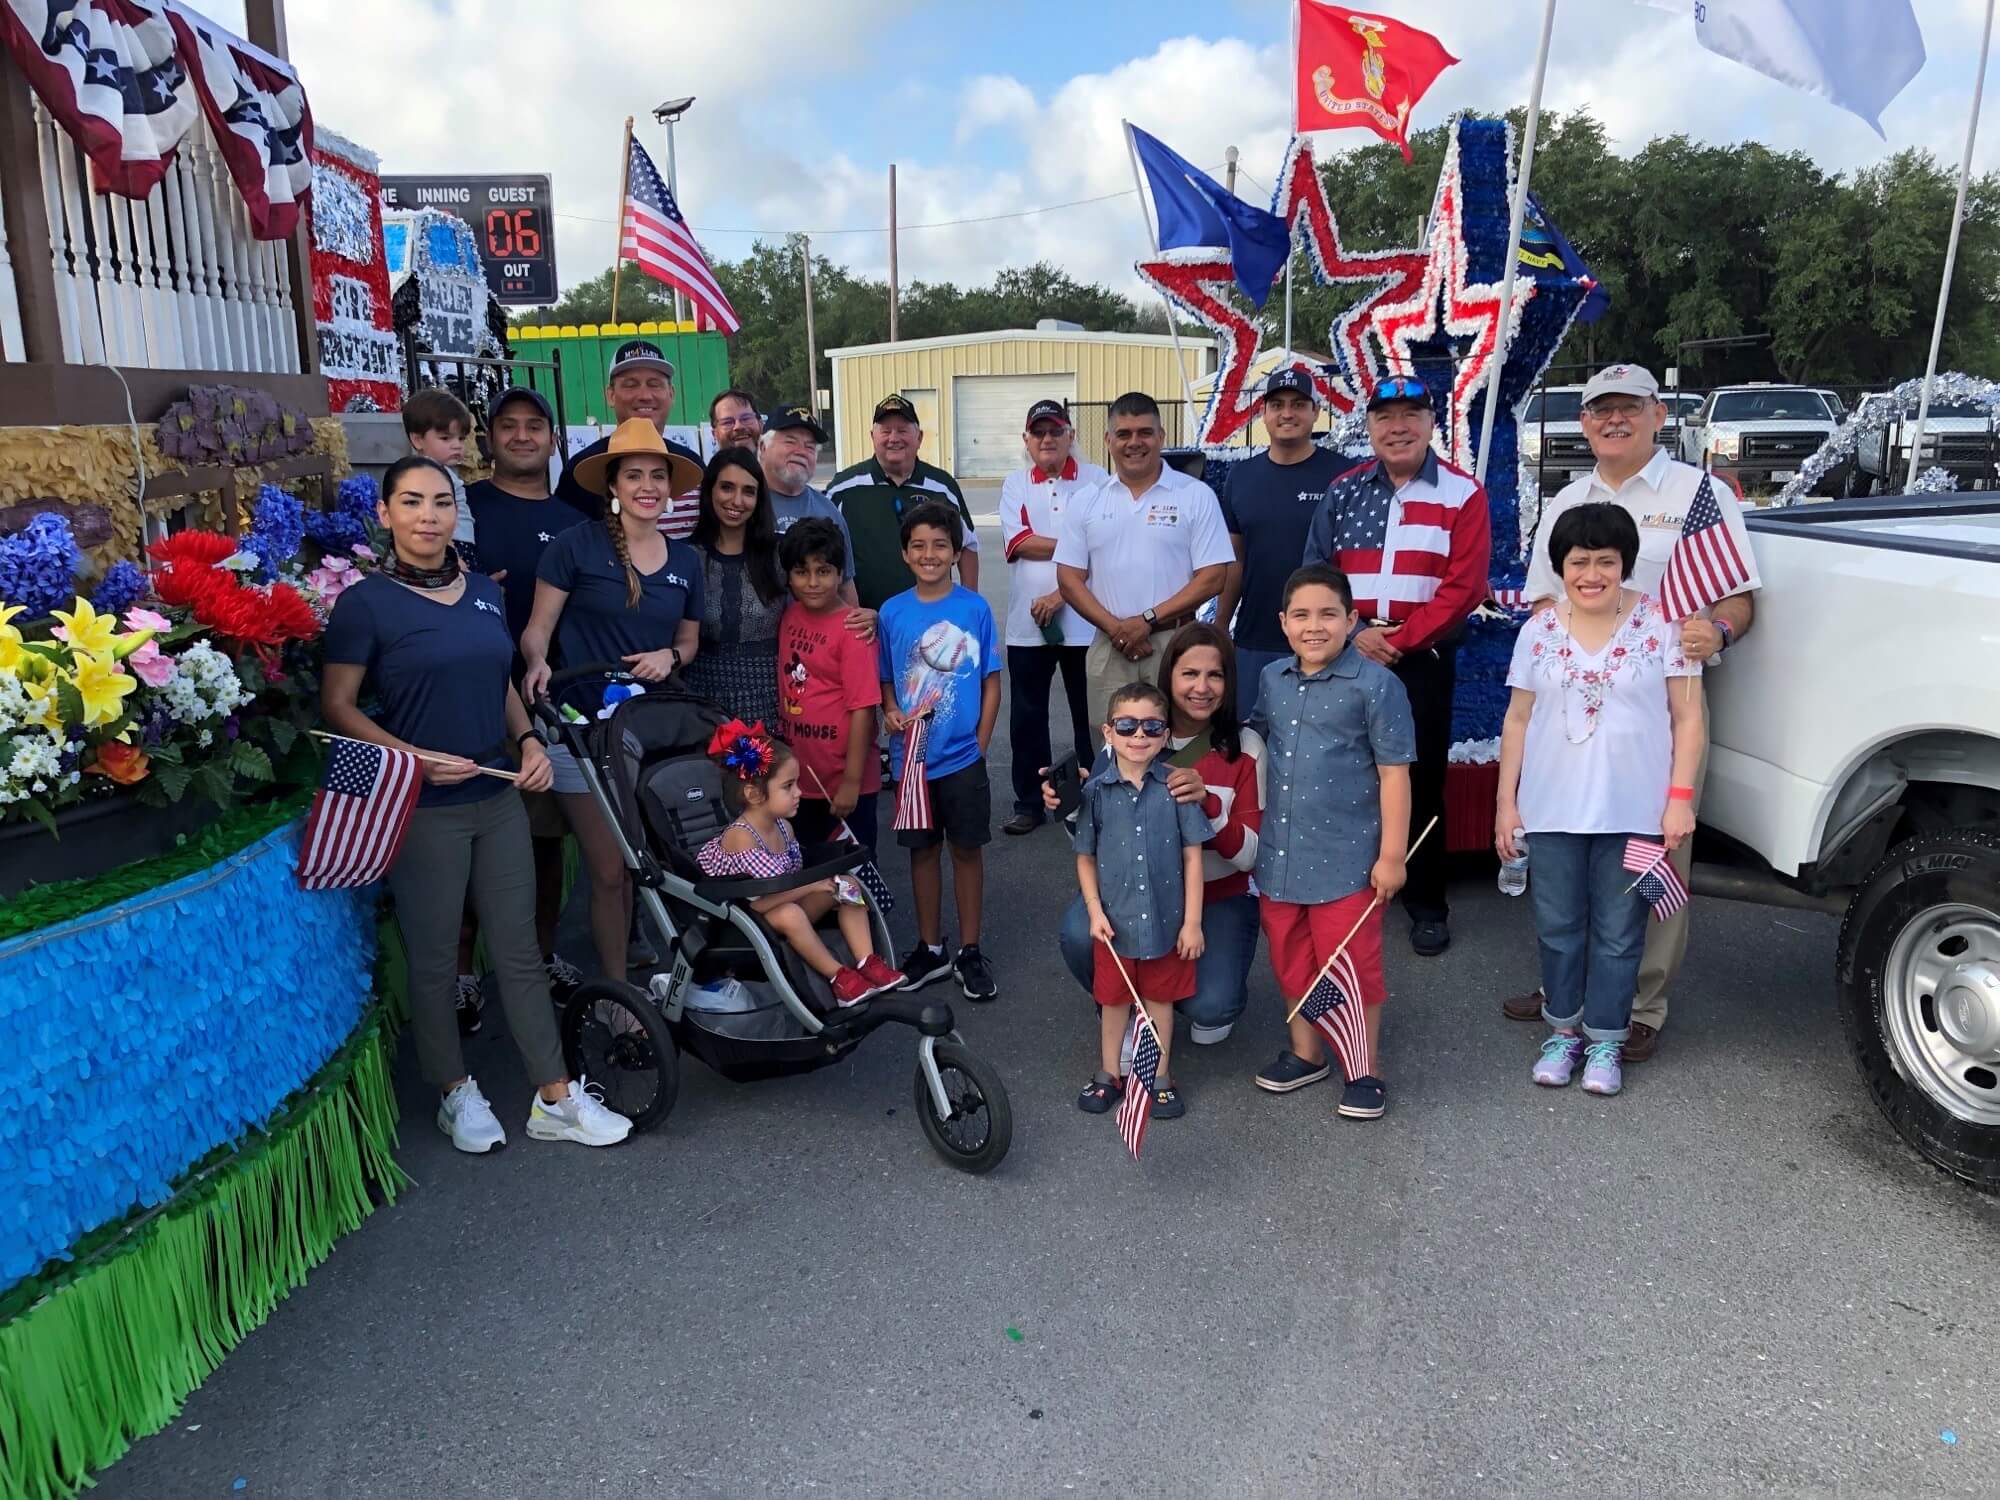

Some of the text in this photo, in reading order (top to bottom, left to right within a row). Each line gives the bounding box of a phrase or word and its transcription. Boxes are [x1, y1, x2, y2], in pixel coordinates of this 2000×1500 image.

[1319, 90, 1352, 112] UNITED
[416, 187, 471, 203] INNING
[488, 187, 536, 202] GUEST
[487, 208, 541, 257] 06
[503, 263, 531, 278] OUT
[794, 722, 838, 740] MOUSE
